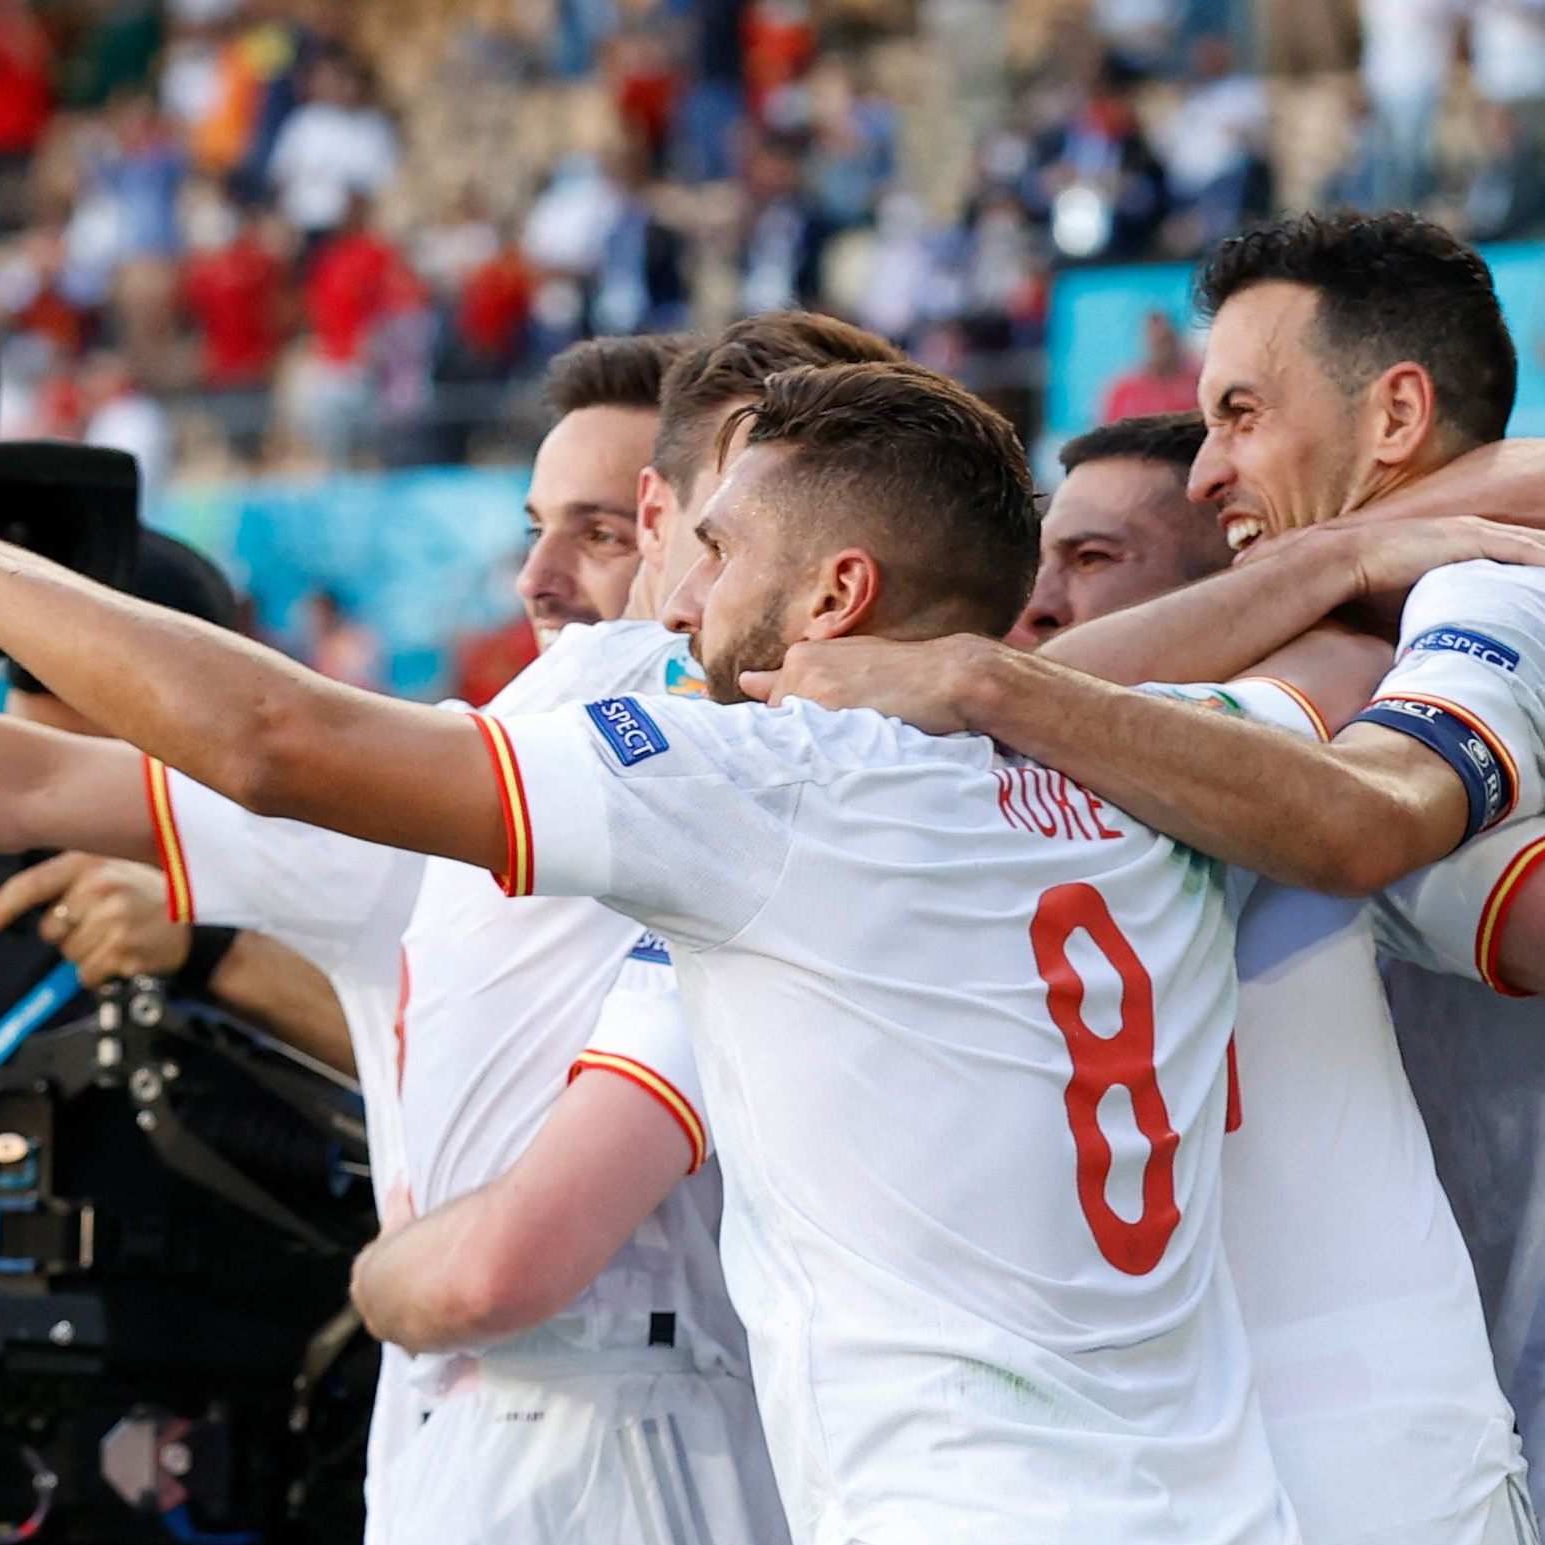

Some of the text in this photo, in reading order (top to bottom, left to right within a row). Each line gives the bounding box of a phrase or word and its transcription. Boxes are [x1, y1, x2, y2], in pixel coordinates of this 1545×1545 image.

[597, 700, 655, 755] SPECT
[992, 767, 1125, 840] KOKE
[1030, 882, 1182, 1276] 8
